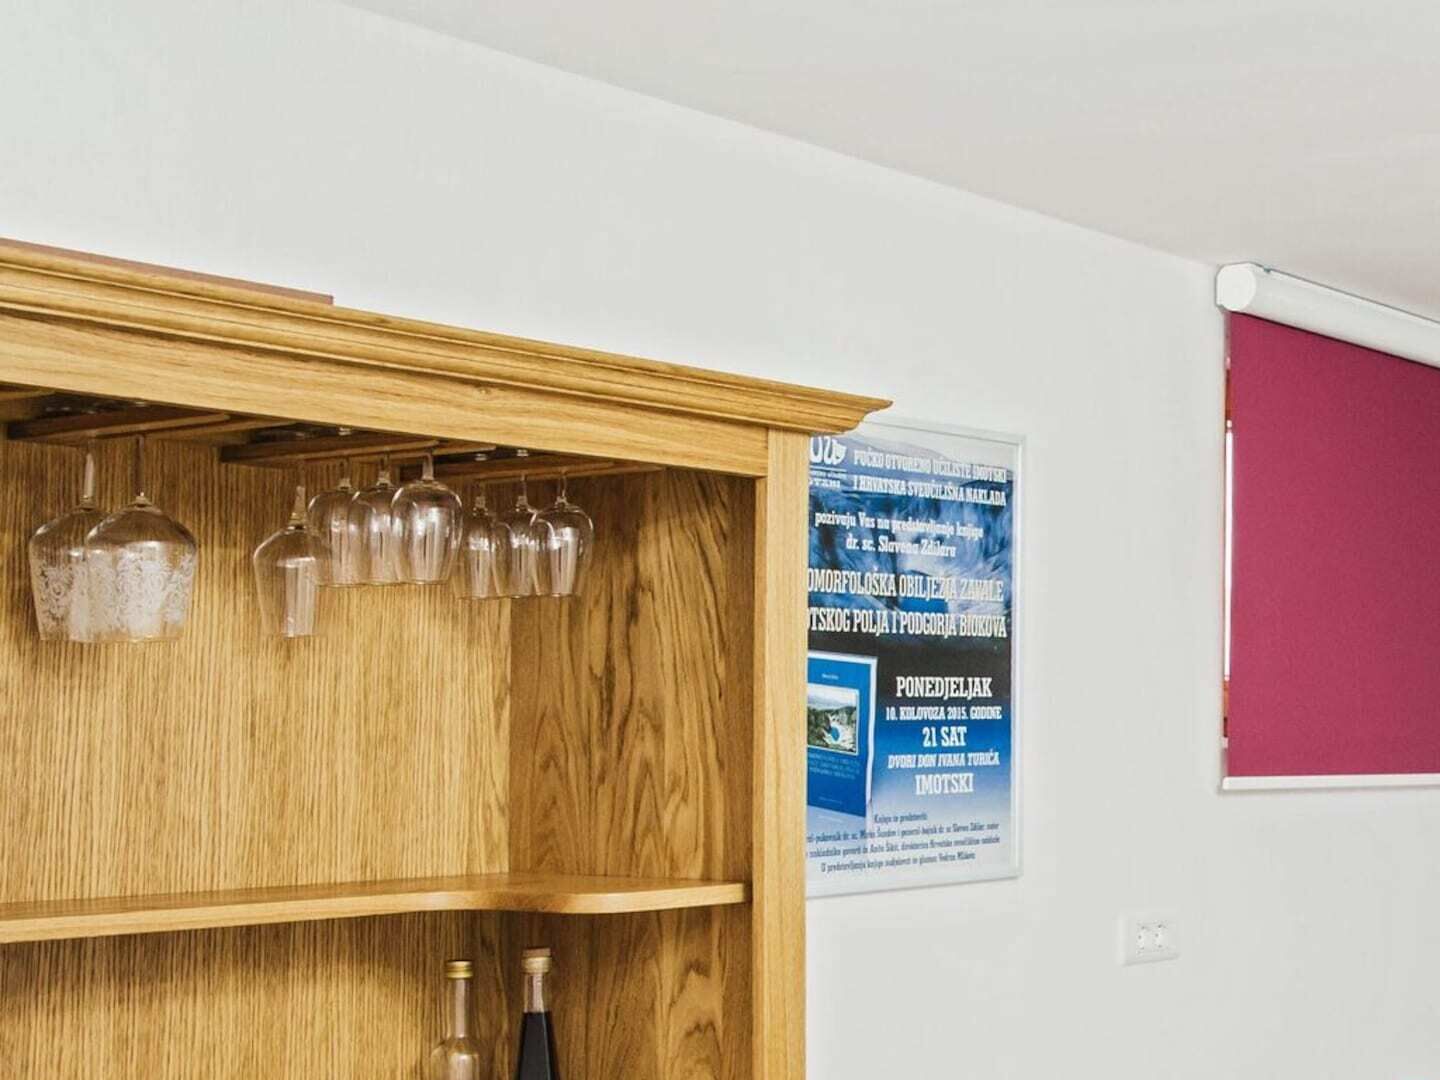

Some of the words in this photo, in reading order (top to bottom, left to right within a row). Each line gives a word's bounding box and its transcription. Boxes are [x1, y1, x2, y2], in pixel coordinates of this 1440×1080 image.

[852, 608, 889, 636] POLJA
[891, 610, 897, 634] I
[899, 612, 957, 639] PODGORJA
[960, 614, 1007, 637] BIOKOVA
[896, 676, 992, 700] PONEDJELJAK
[922, 726, 938, 747] 21
[940, 726, 967, 747] SAT
[915, 773, 974, 795] IMOTSKI
